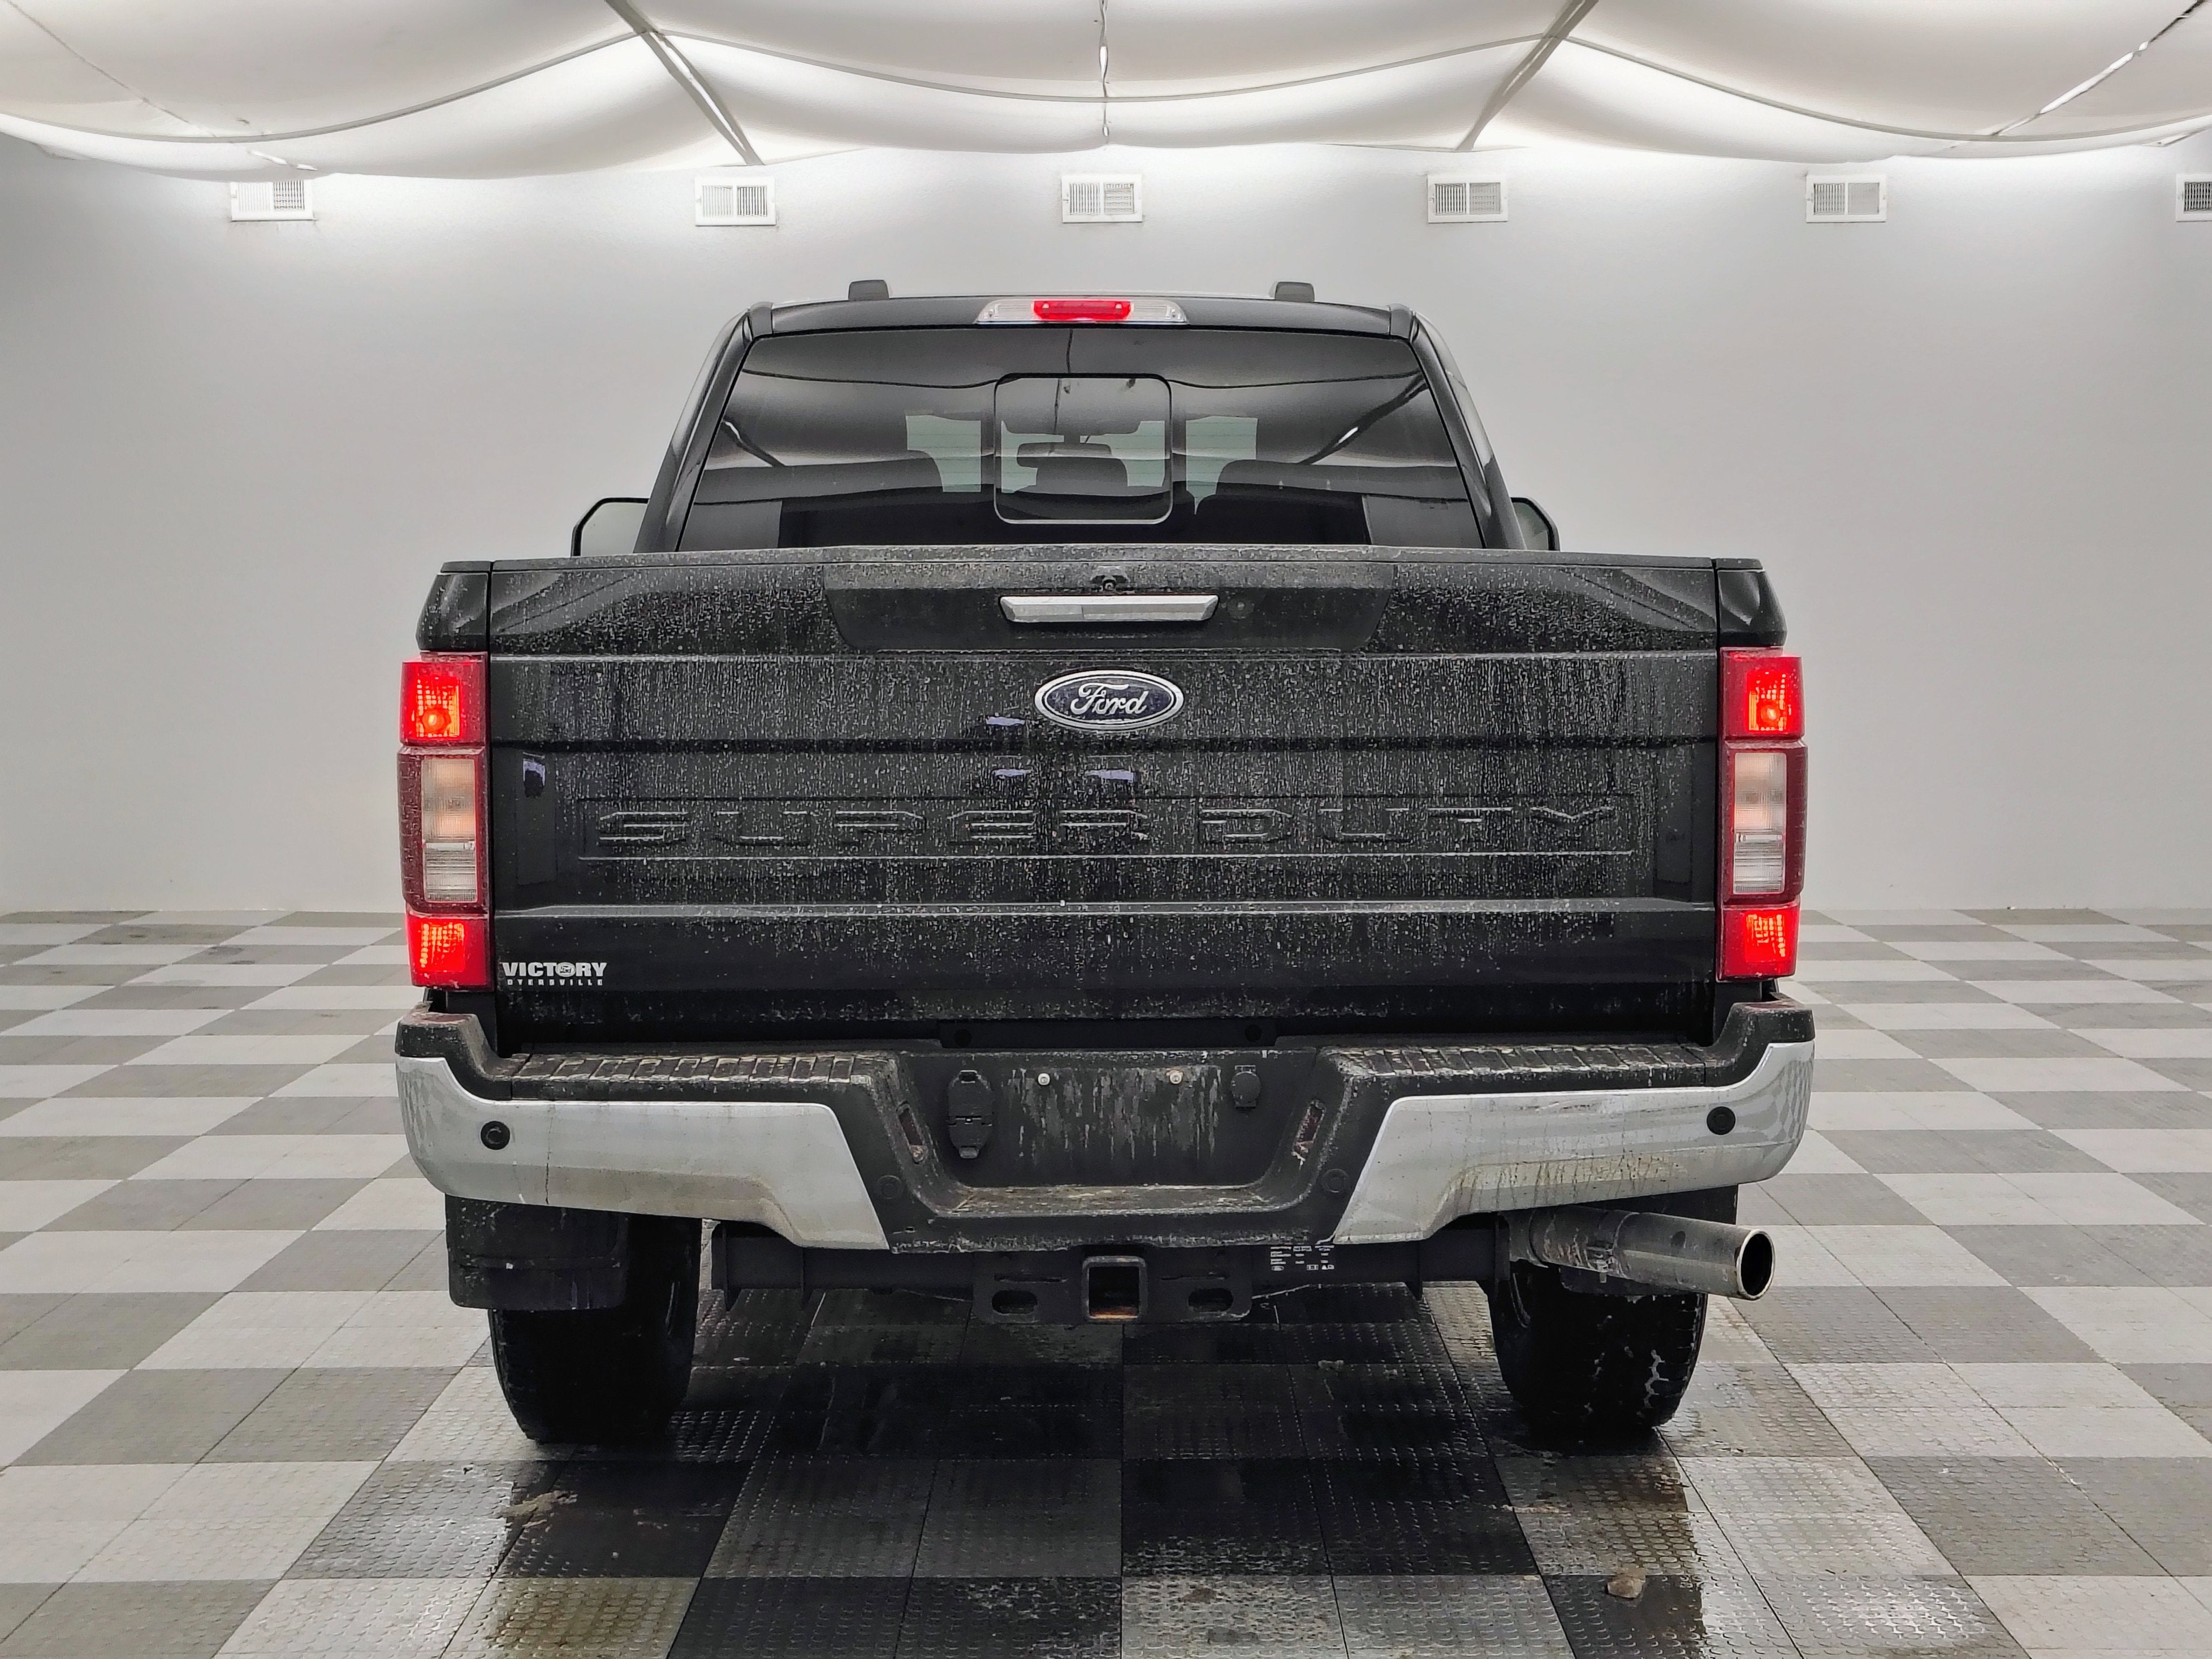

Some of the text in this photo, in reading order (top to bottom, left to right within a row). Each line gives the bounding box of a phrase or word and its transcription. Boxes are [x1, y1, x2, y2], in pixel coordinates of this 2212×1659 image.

[1070, 682, 1149, 715] Ford
[598, 807, 1616, 847] SUPER DUTY
[501, 962, 608, 977] VICTORY
